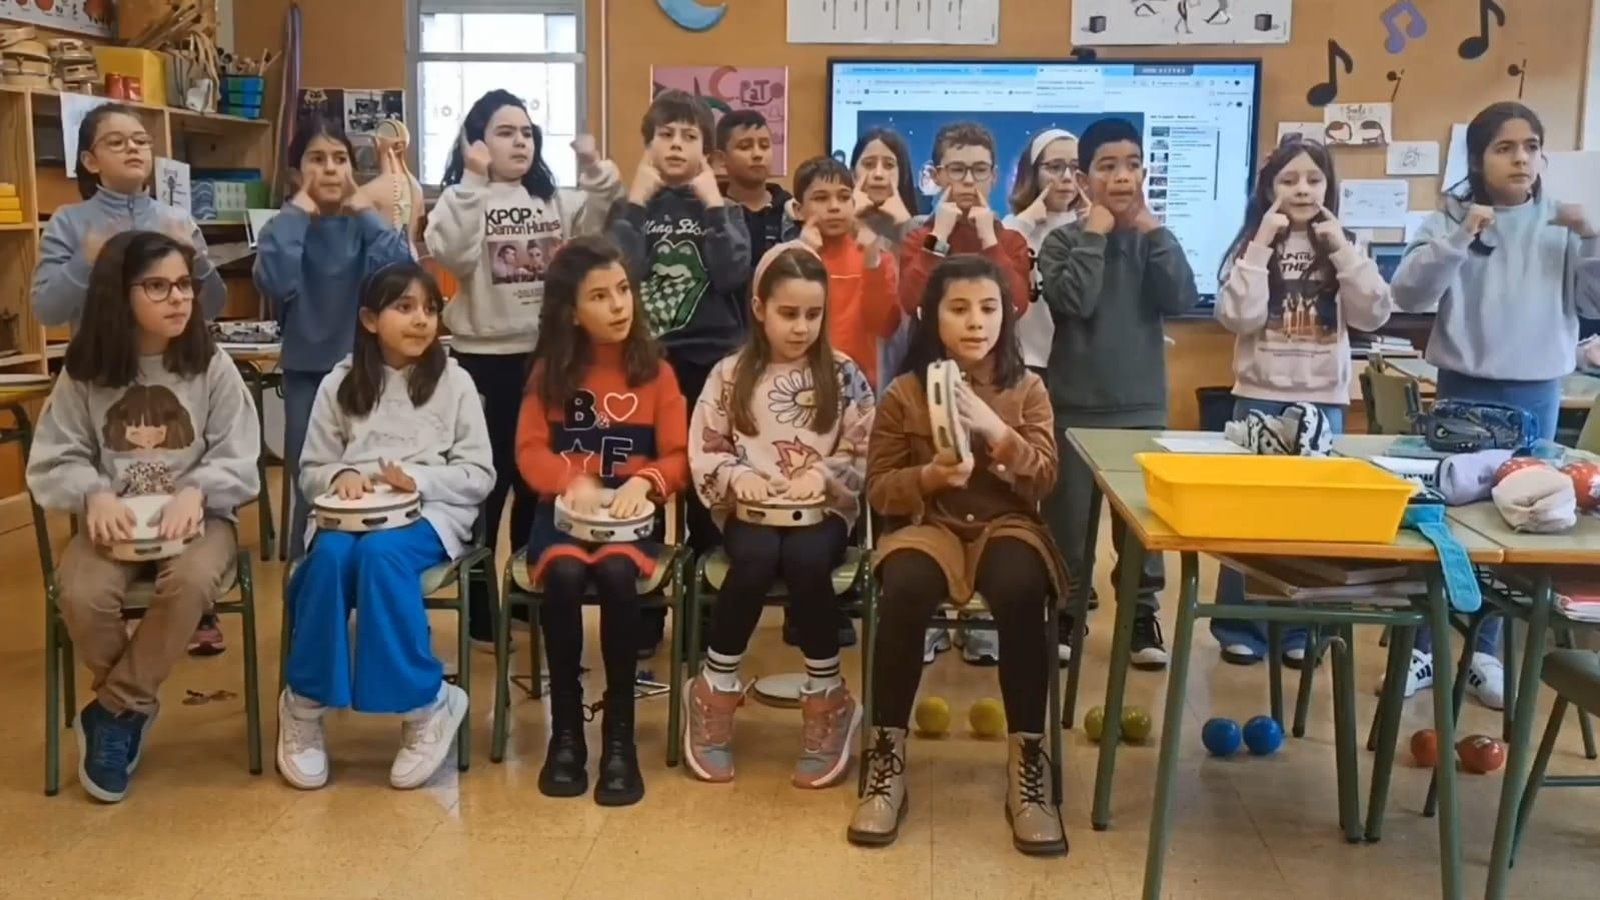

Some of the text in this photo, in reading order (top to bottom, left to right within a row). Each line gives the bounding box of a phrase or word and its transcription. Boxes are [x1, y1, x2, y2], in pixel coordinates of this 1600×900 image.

[485, 207, 532, 225] KPOP
[486, 224, 526, 236] Demon
[563, 388, 610, 431] B &
[599, 435, 634, 478] F
